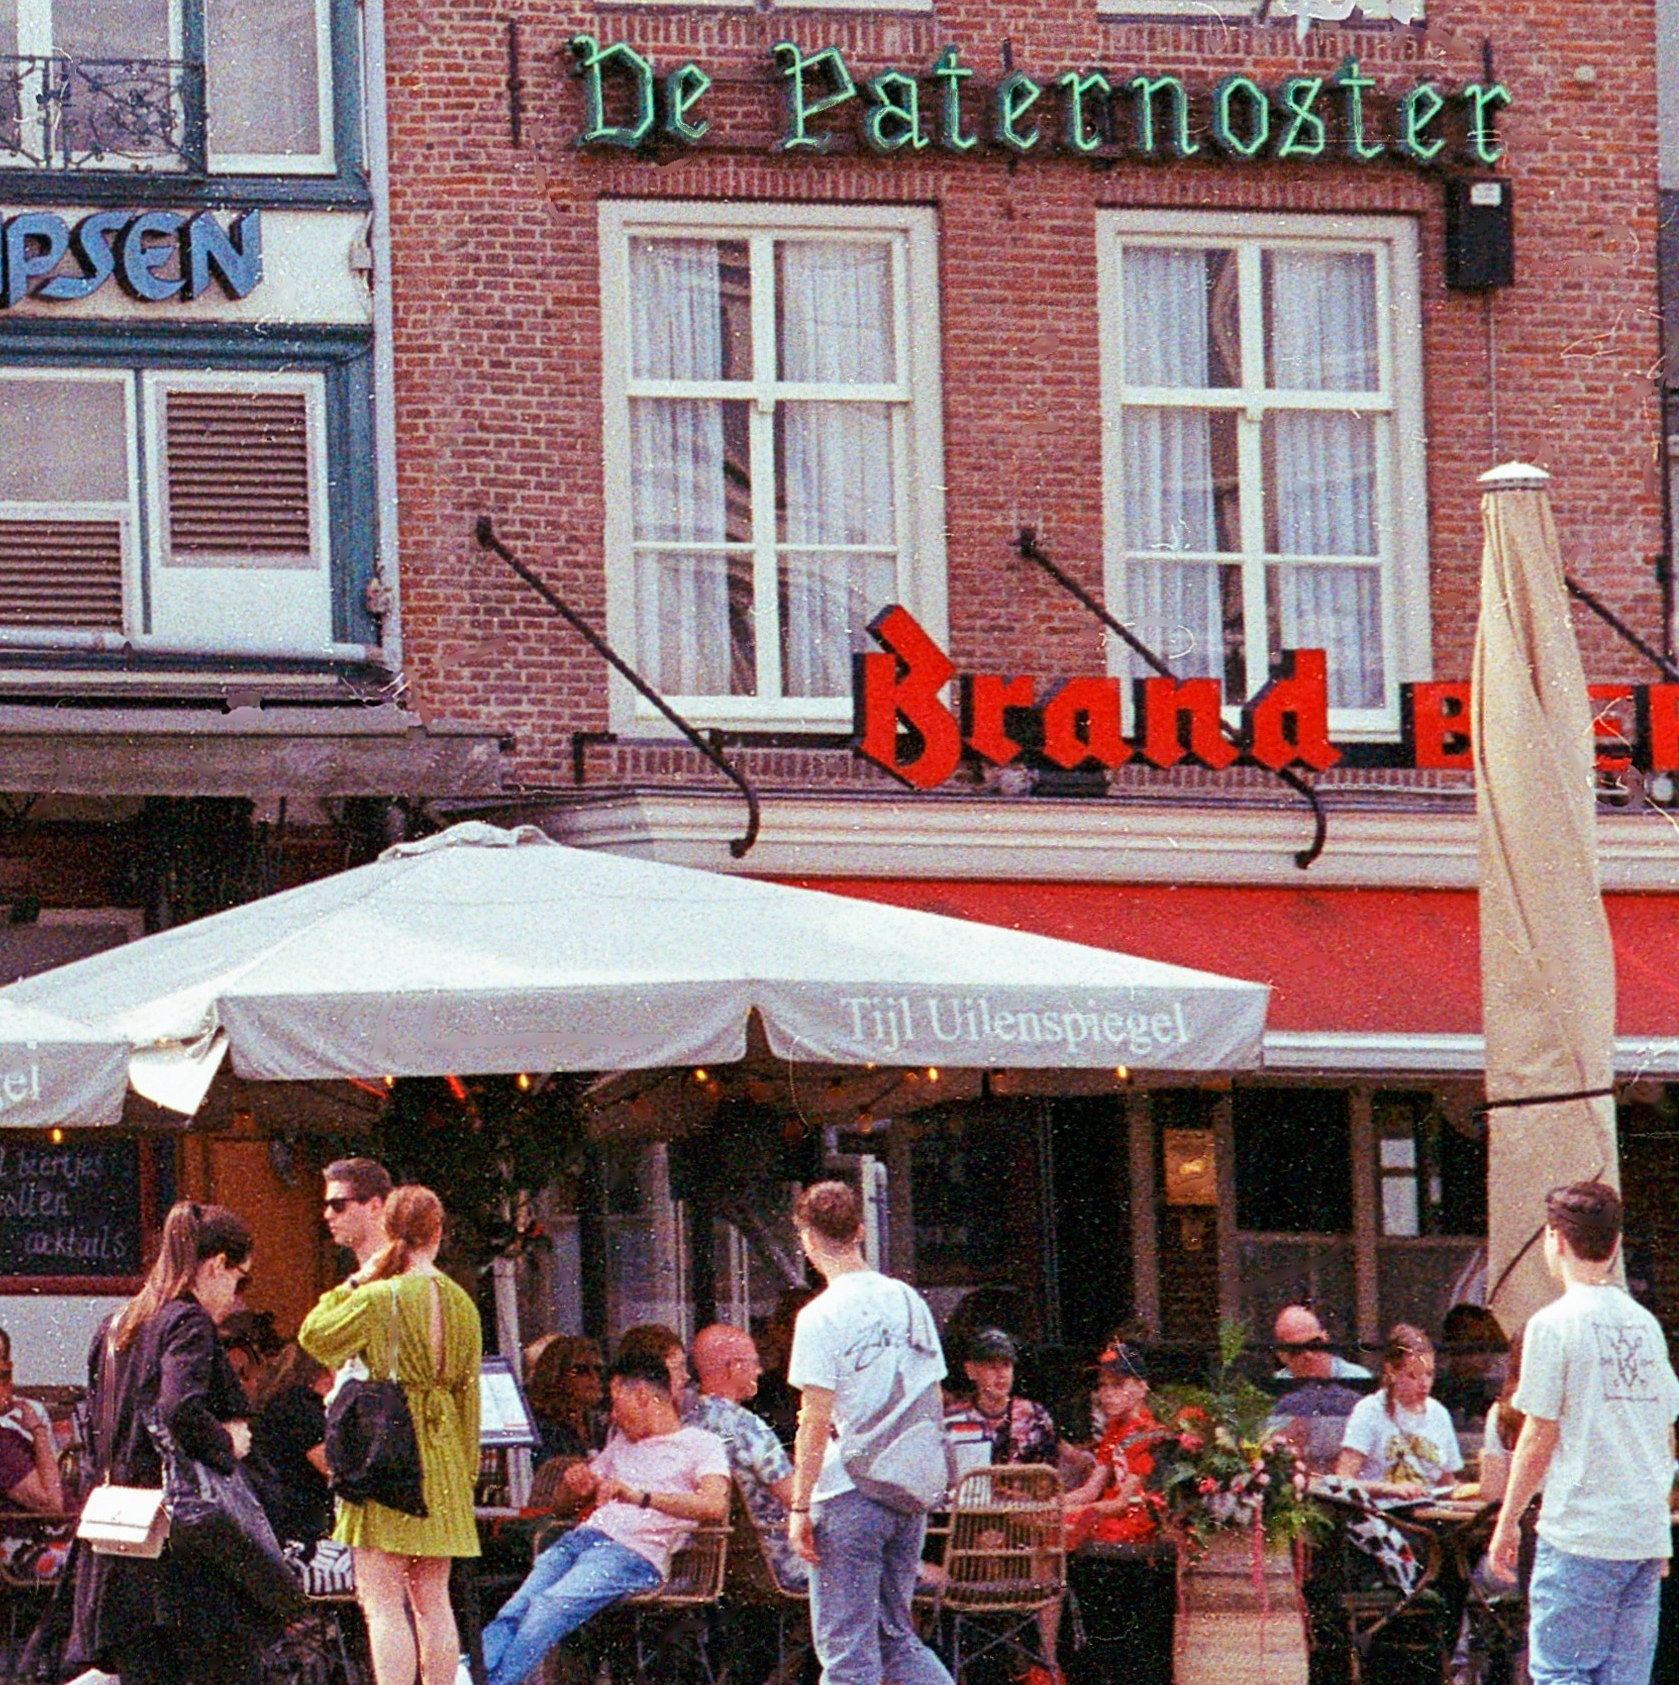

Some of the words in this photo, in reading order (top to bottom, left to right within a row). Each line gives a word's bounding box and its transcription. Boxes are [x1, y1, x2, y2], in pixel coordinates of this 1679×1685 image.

[563, 34, 713, 147] De
[771, 38, 1513, 165] Paternoster
[852, 603, 1344, 791] Brand
[840, 996, 914, 1053] Tijl
[929, 996, 1191, 1056] Uilenspiegel
